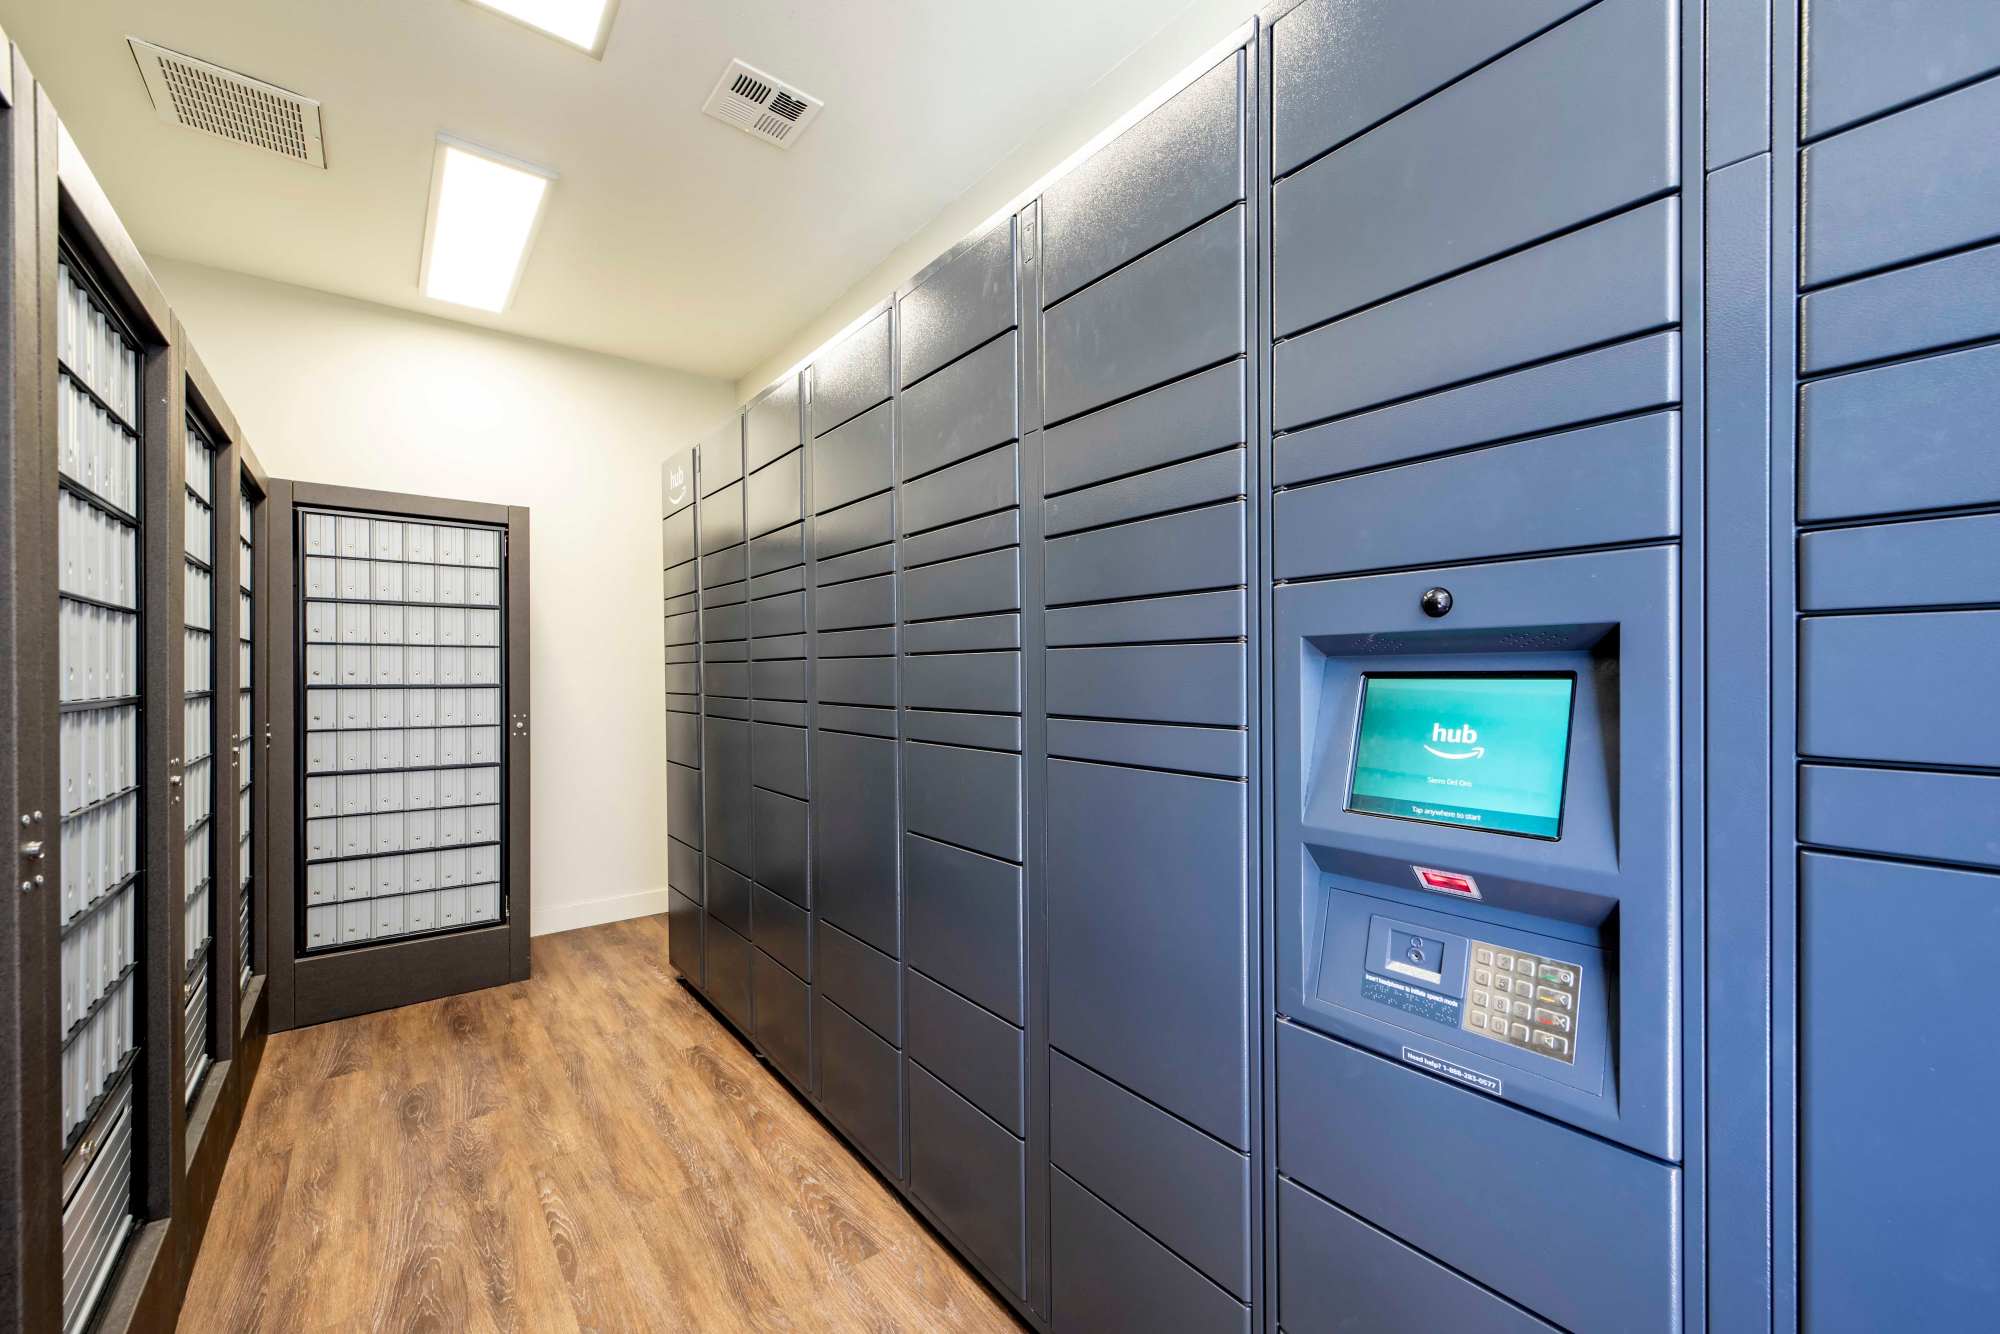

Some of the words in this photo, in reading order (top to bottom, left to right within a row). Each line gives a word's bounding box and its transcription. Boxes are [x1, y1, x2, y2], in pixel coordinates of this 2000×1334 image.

[670, 466, 684, 489] hub
[1431, 722, 1478, 744] hub
[1412, 806, 1424, 816] Tap
[1424, 808, 1456, 819] anywhere
[1456, 811, 1465, 819] to
[1465, 813, 1481, 821] start
[1407, 1052, 1423, 1063] Need
[1424, 1059, 1441, 1070] help?
